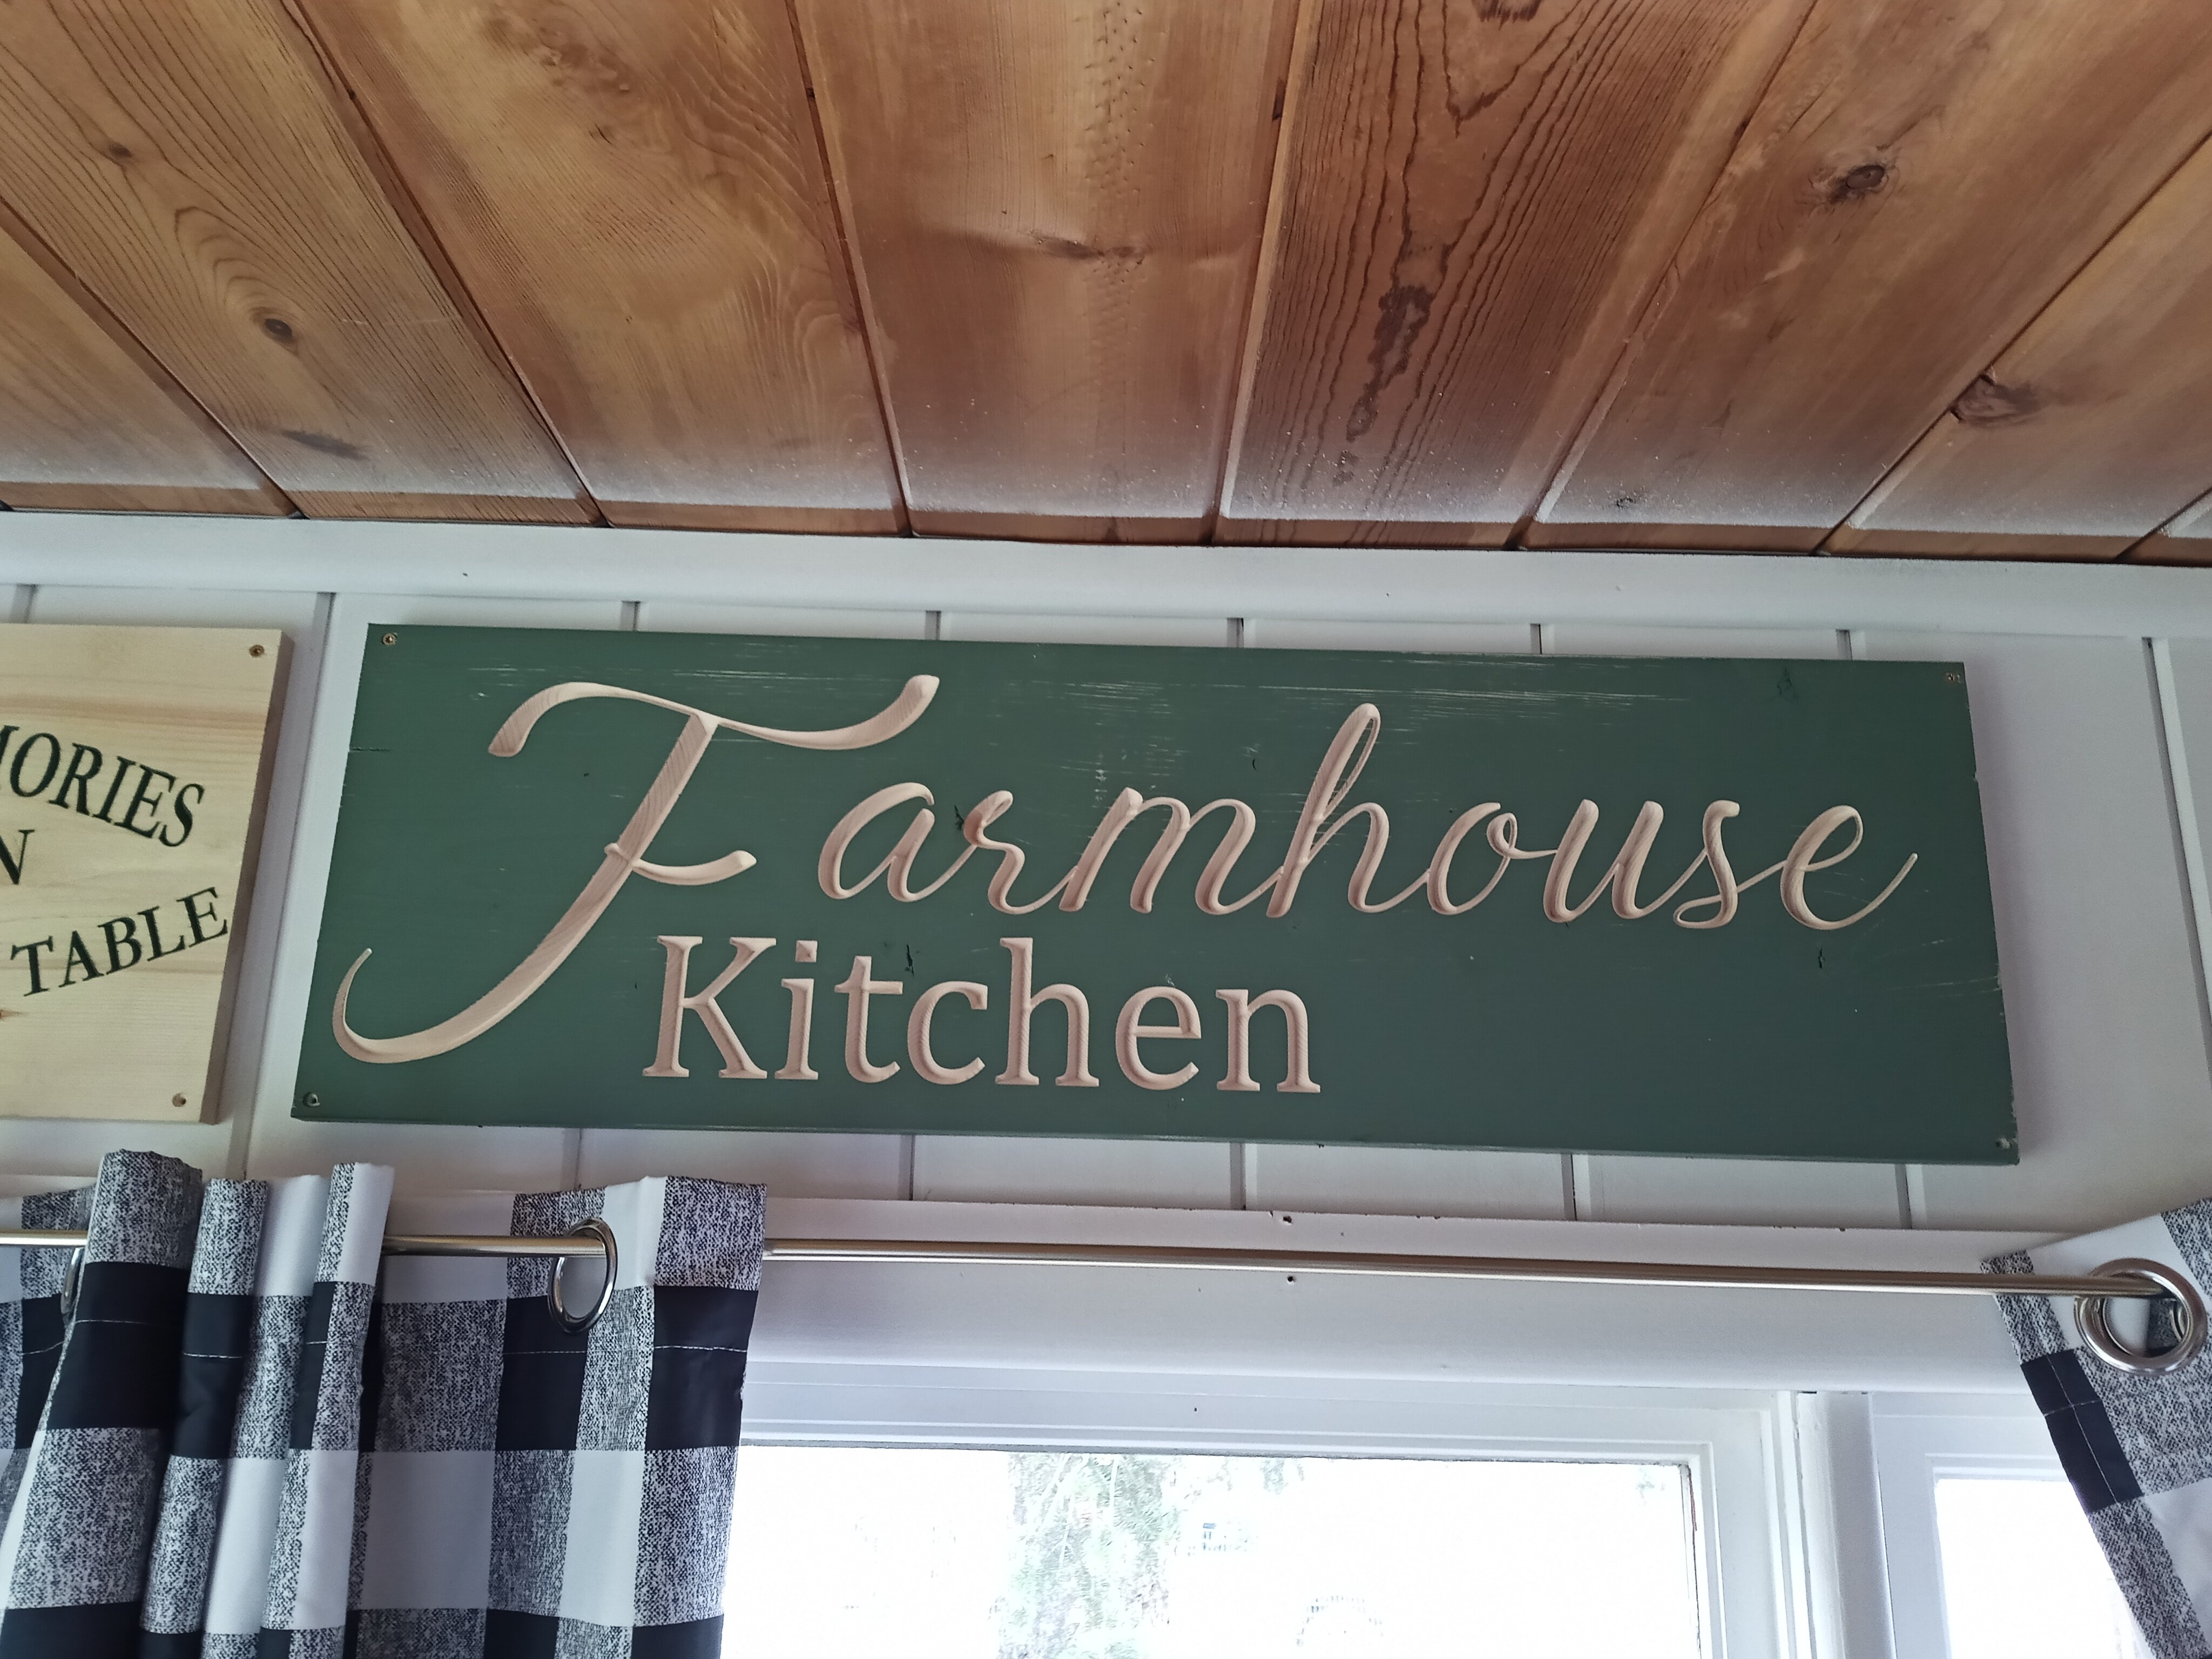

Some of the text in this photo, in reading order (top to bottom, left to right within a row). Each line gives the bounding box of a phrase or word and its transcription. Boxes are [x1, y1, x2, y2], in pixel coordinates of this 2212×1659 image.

[10, 887, 228, 997] TABLE
[333, 675, 1920, 1064] Farmhouse
[643, 935, 1321, 1094] Kitchen
